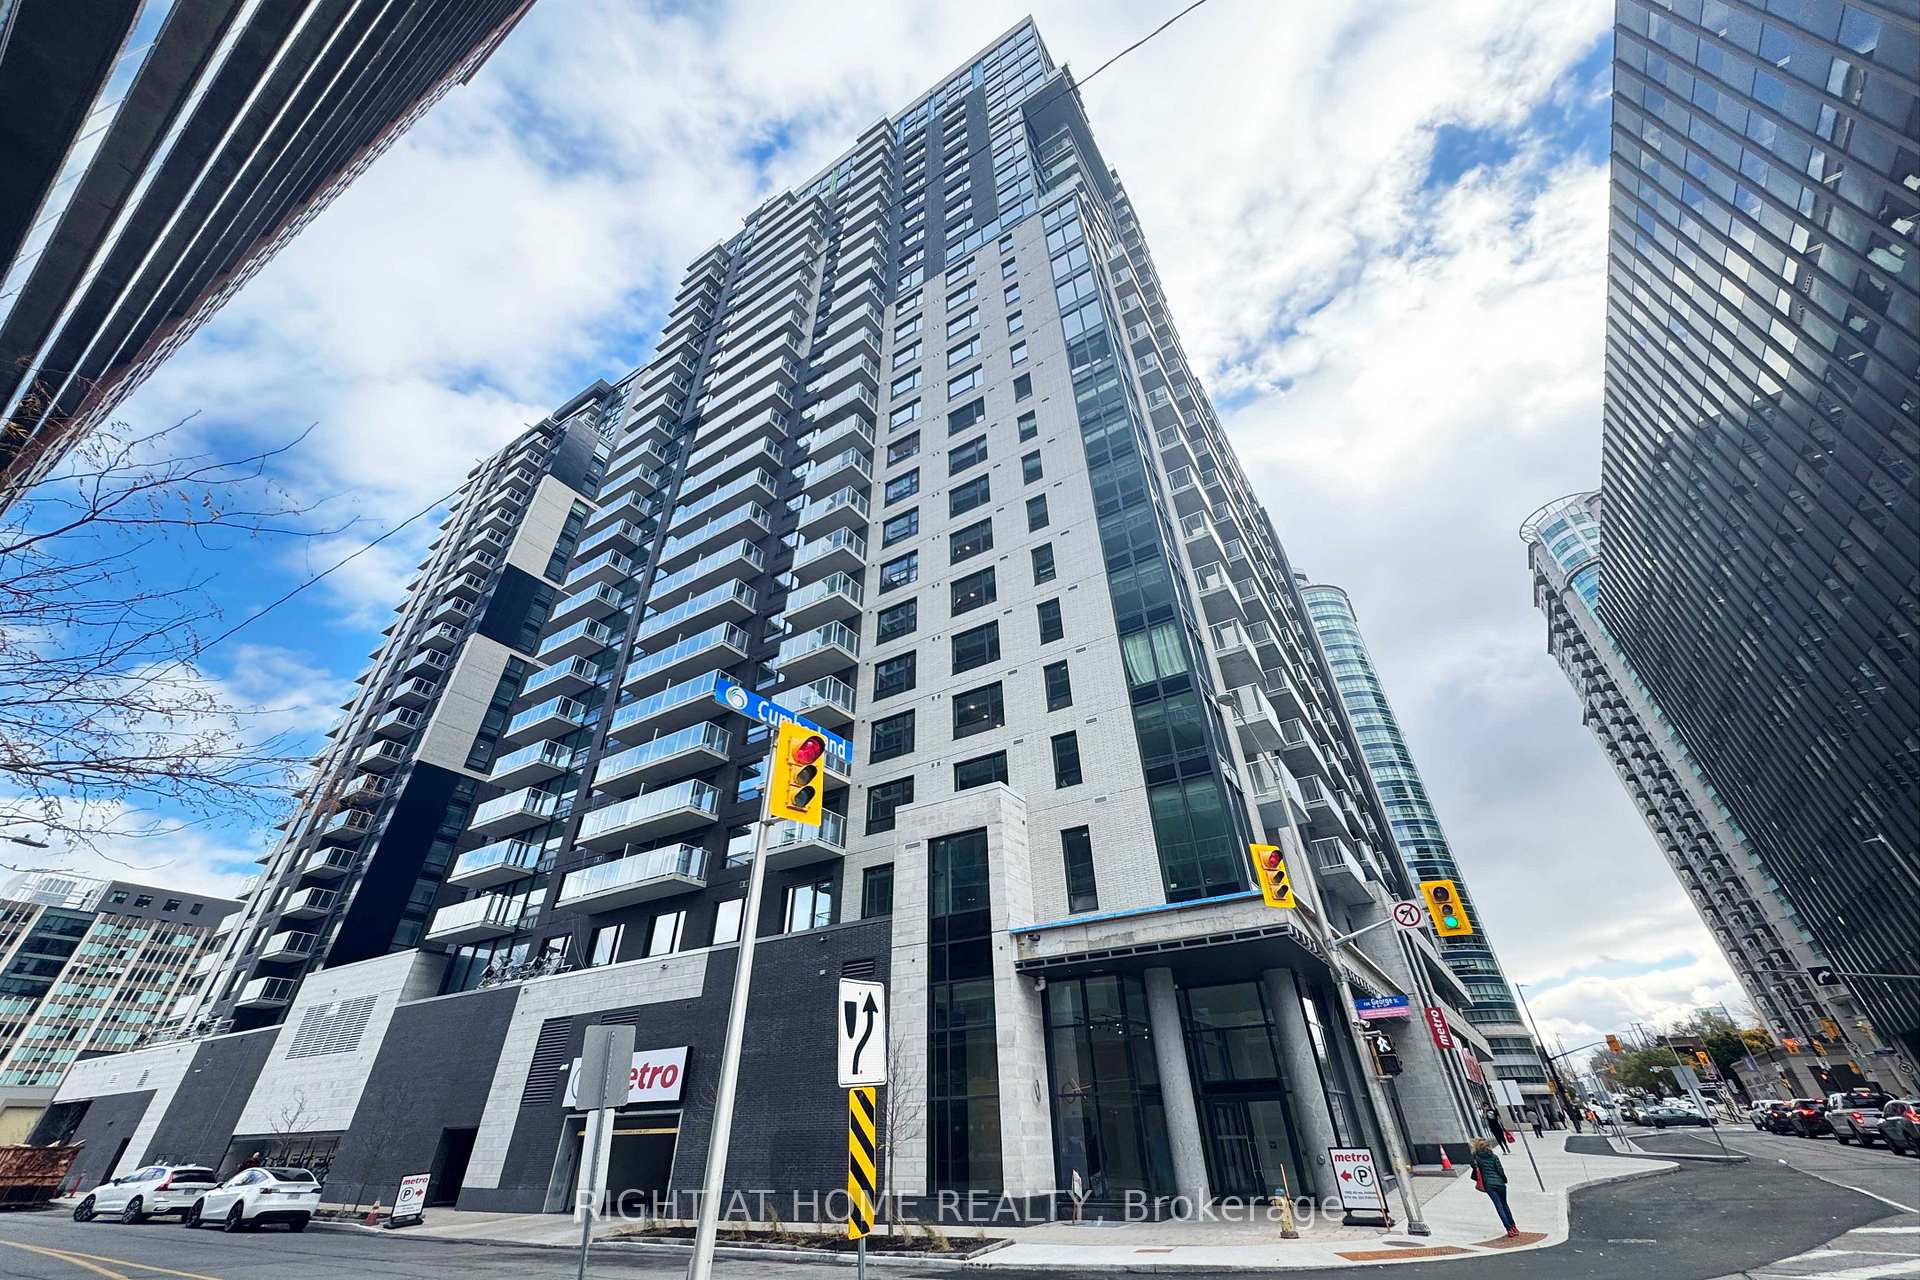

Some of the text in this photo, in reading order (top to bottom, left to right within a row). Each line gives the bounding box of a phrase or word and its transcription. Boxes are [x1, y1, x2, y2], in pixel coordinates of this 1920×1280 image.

[1430, 1009, 1450, 1046] metro
[629, 1062, 679, 1090] etro
[1334, 1153, 1370, 1162] metro
[403, 1177, 428, 1185] metro
